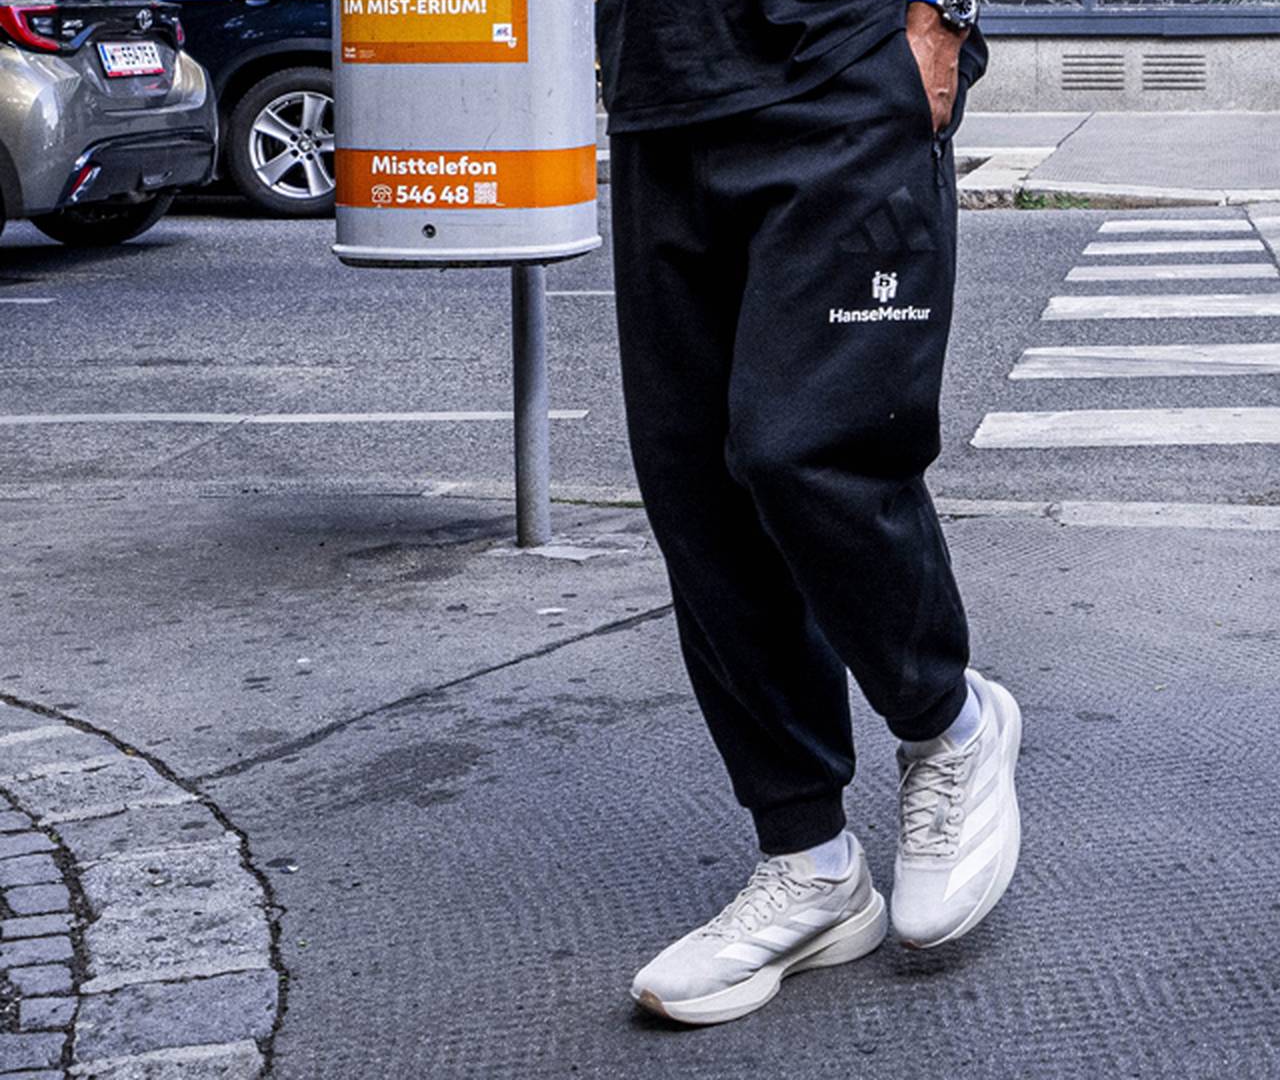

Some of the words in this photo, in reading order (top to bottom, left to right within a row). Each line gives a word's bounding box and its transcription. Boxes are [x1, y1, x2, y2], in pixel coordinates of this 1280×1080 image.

[343, 0, 363, 15] IM
[371, 155, 497, 175] Misttelefon
[395, 184, 437, 204] 546
[440, 184, 470, 204] 48
[829, 305, 931, 323] HanseMerkur
